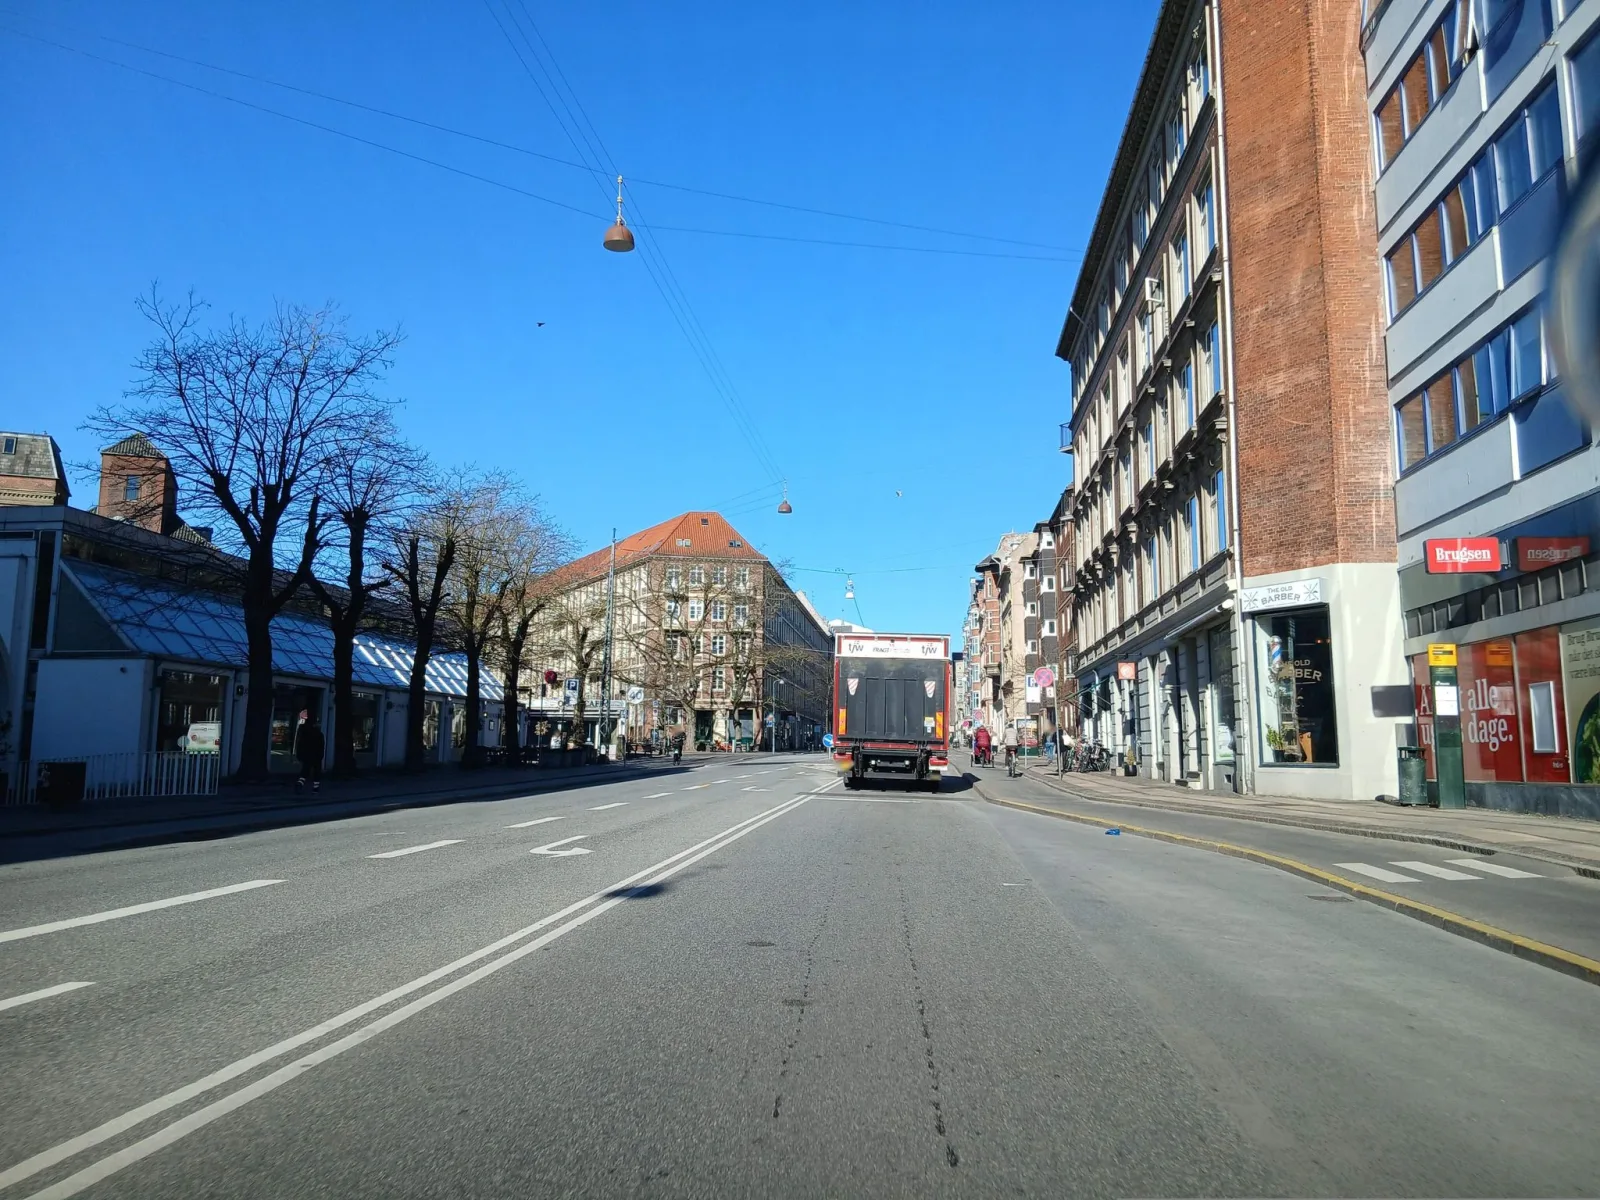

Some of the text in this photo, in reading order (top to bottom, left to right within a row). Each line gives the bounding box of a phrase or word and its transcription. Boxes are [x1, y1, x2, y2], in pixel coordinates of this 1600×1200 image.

[1435, 546, 1491, 561] Brugsen
[1260, 592, 1301, 605] BARBER
[1294, 659, 1311, 667] OLD
[569, 681, 576, 690] P
[1467, 679, 1499, 711] alle
[1467, 715, 1514, 752] dage.
